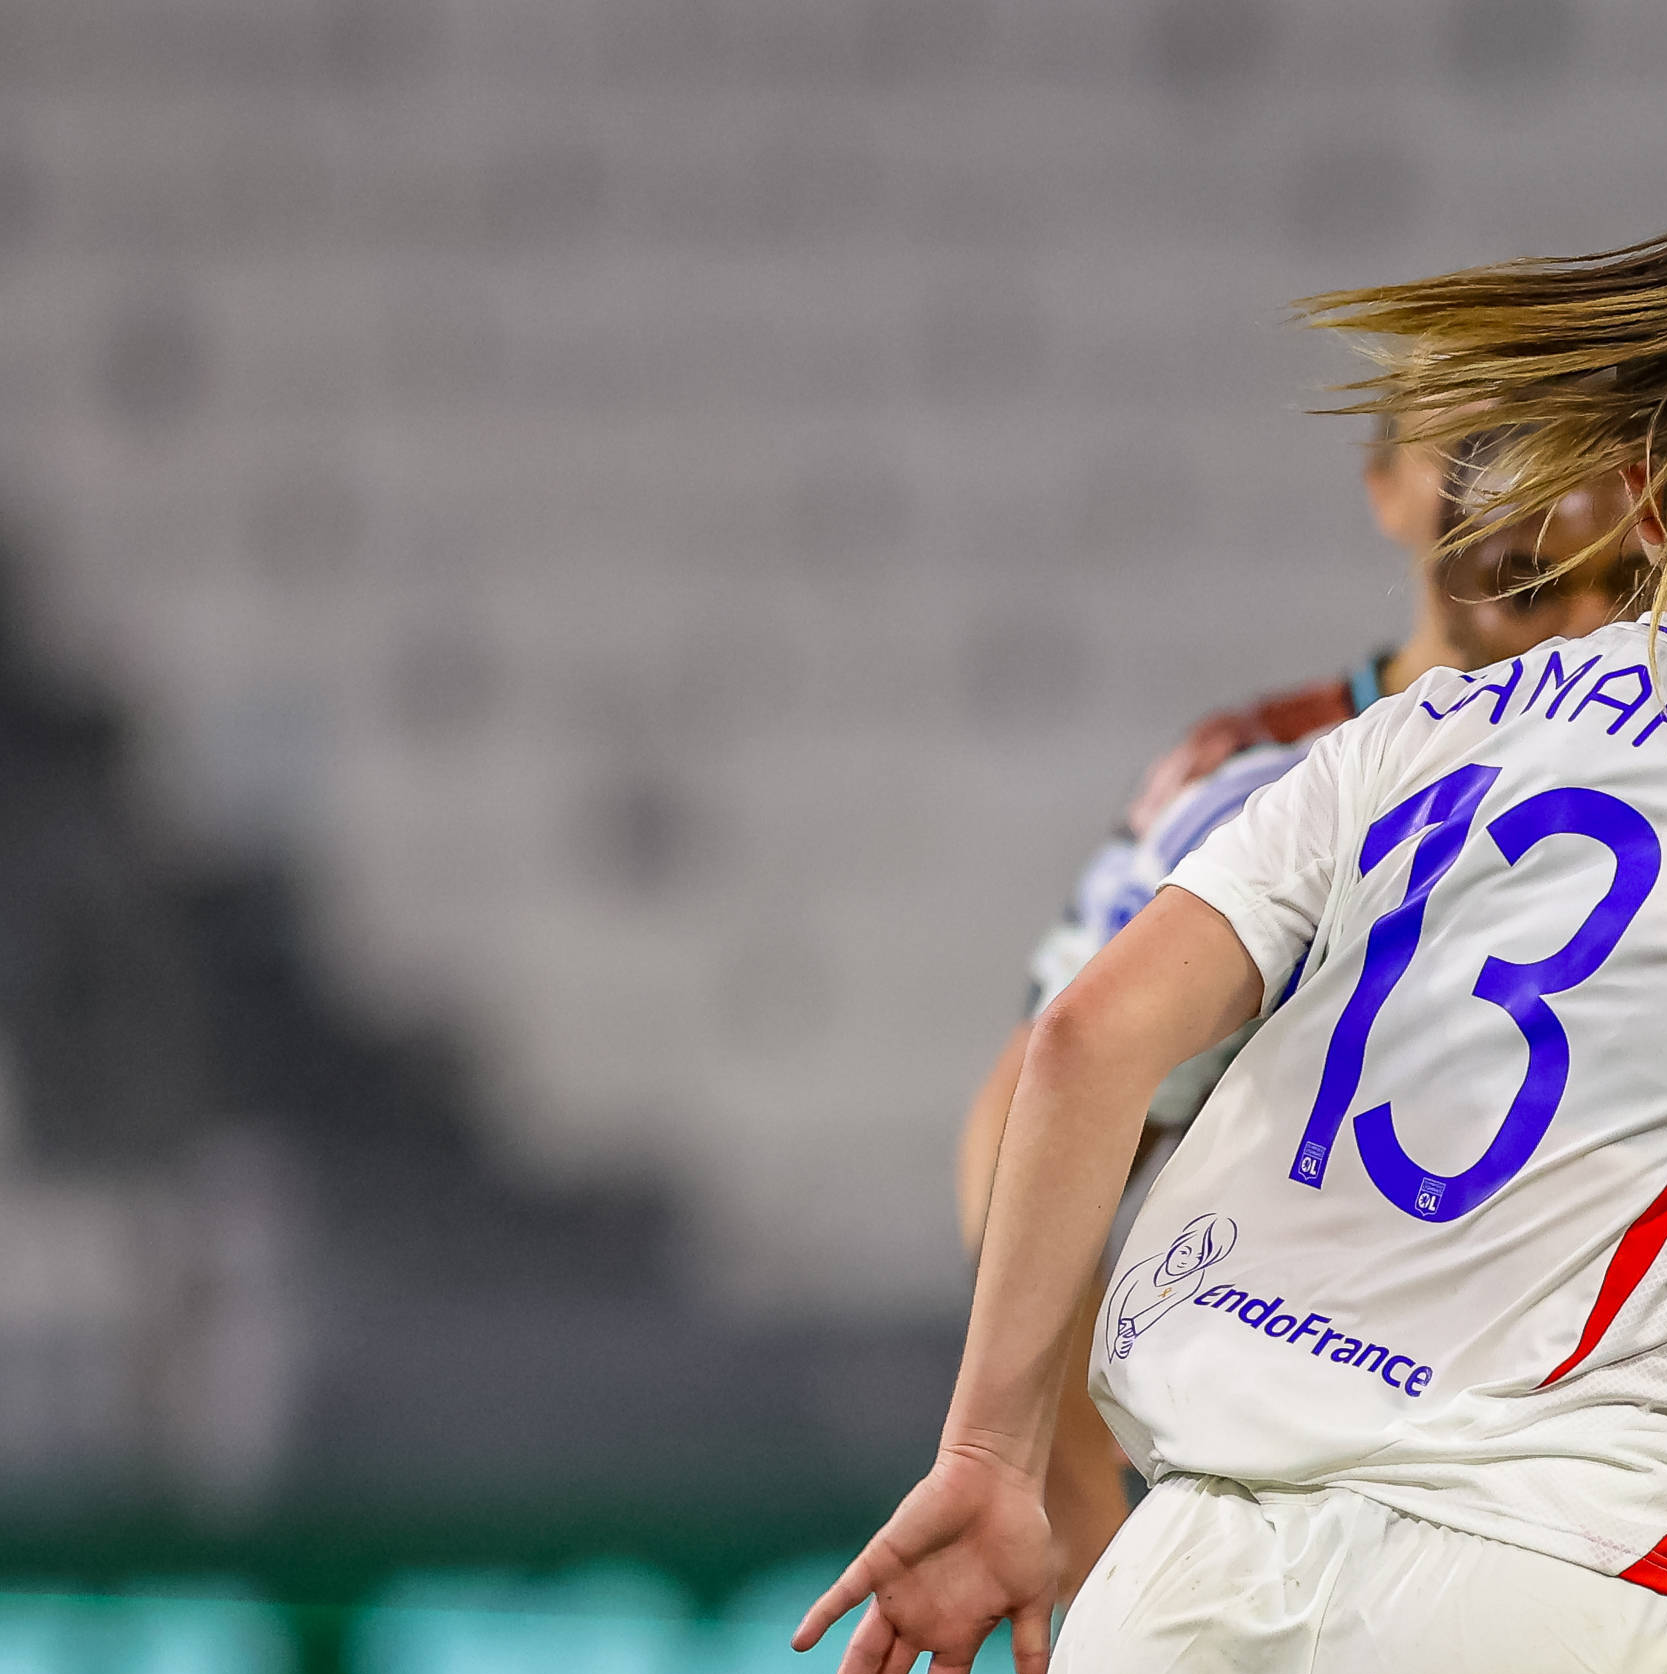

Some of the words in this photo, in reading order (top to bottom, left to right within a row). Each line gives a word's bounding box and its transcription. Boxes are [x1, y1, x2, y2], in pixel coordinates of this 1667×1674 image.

[1288, 762, 1662, 1223] 13
[1301, 1156, 1318, 1176] OL
[1418, 1192, 1437, 1212] OL
[1193, 1283, 1434, 1398] EndoFrance
